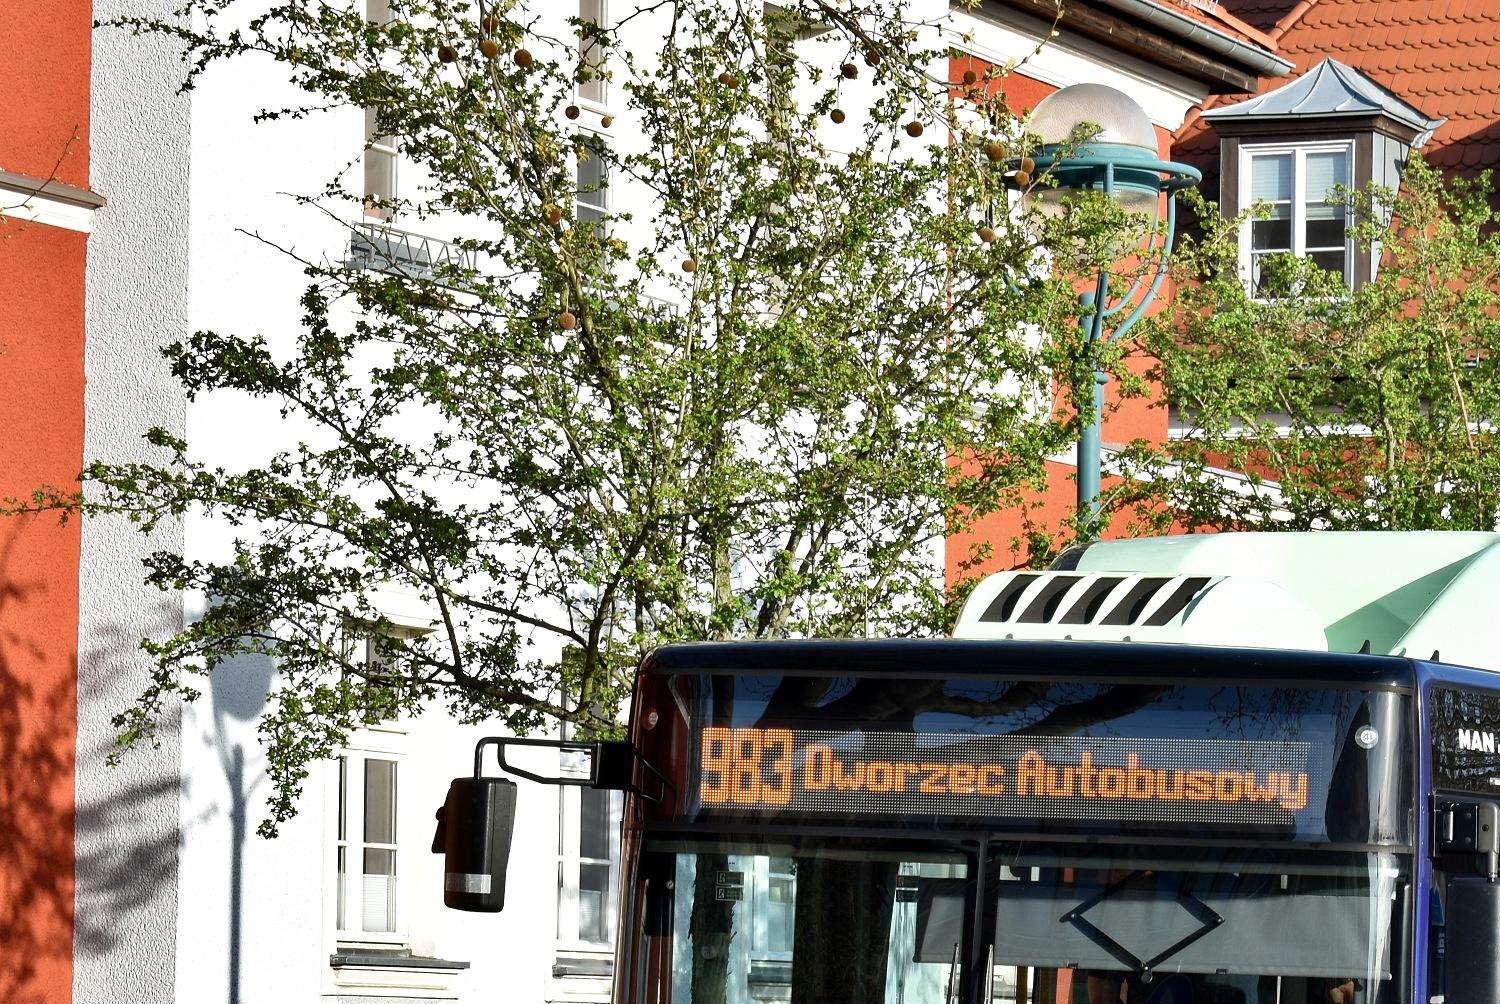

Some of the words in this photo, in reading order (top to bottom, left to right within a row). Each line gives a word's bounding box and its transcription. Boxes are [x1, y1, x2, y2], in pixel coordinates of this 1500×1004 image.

[1458, 728, 1495, 754] MAN
[700, 727, 795, 806] 983
[804, 744, 1006, 795] Dworzec
[1017, 749, 1309, 811] Autobusowy
